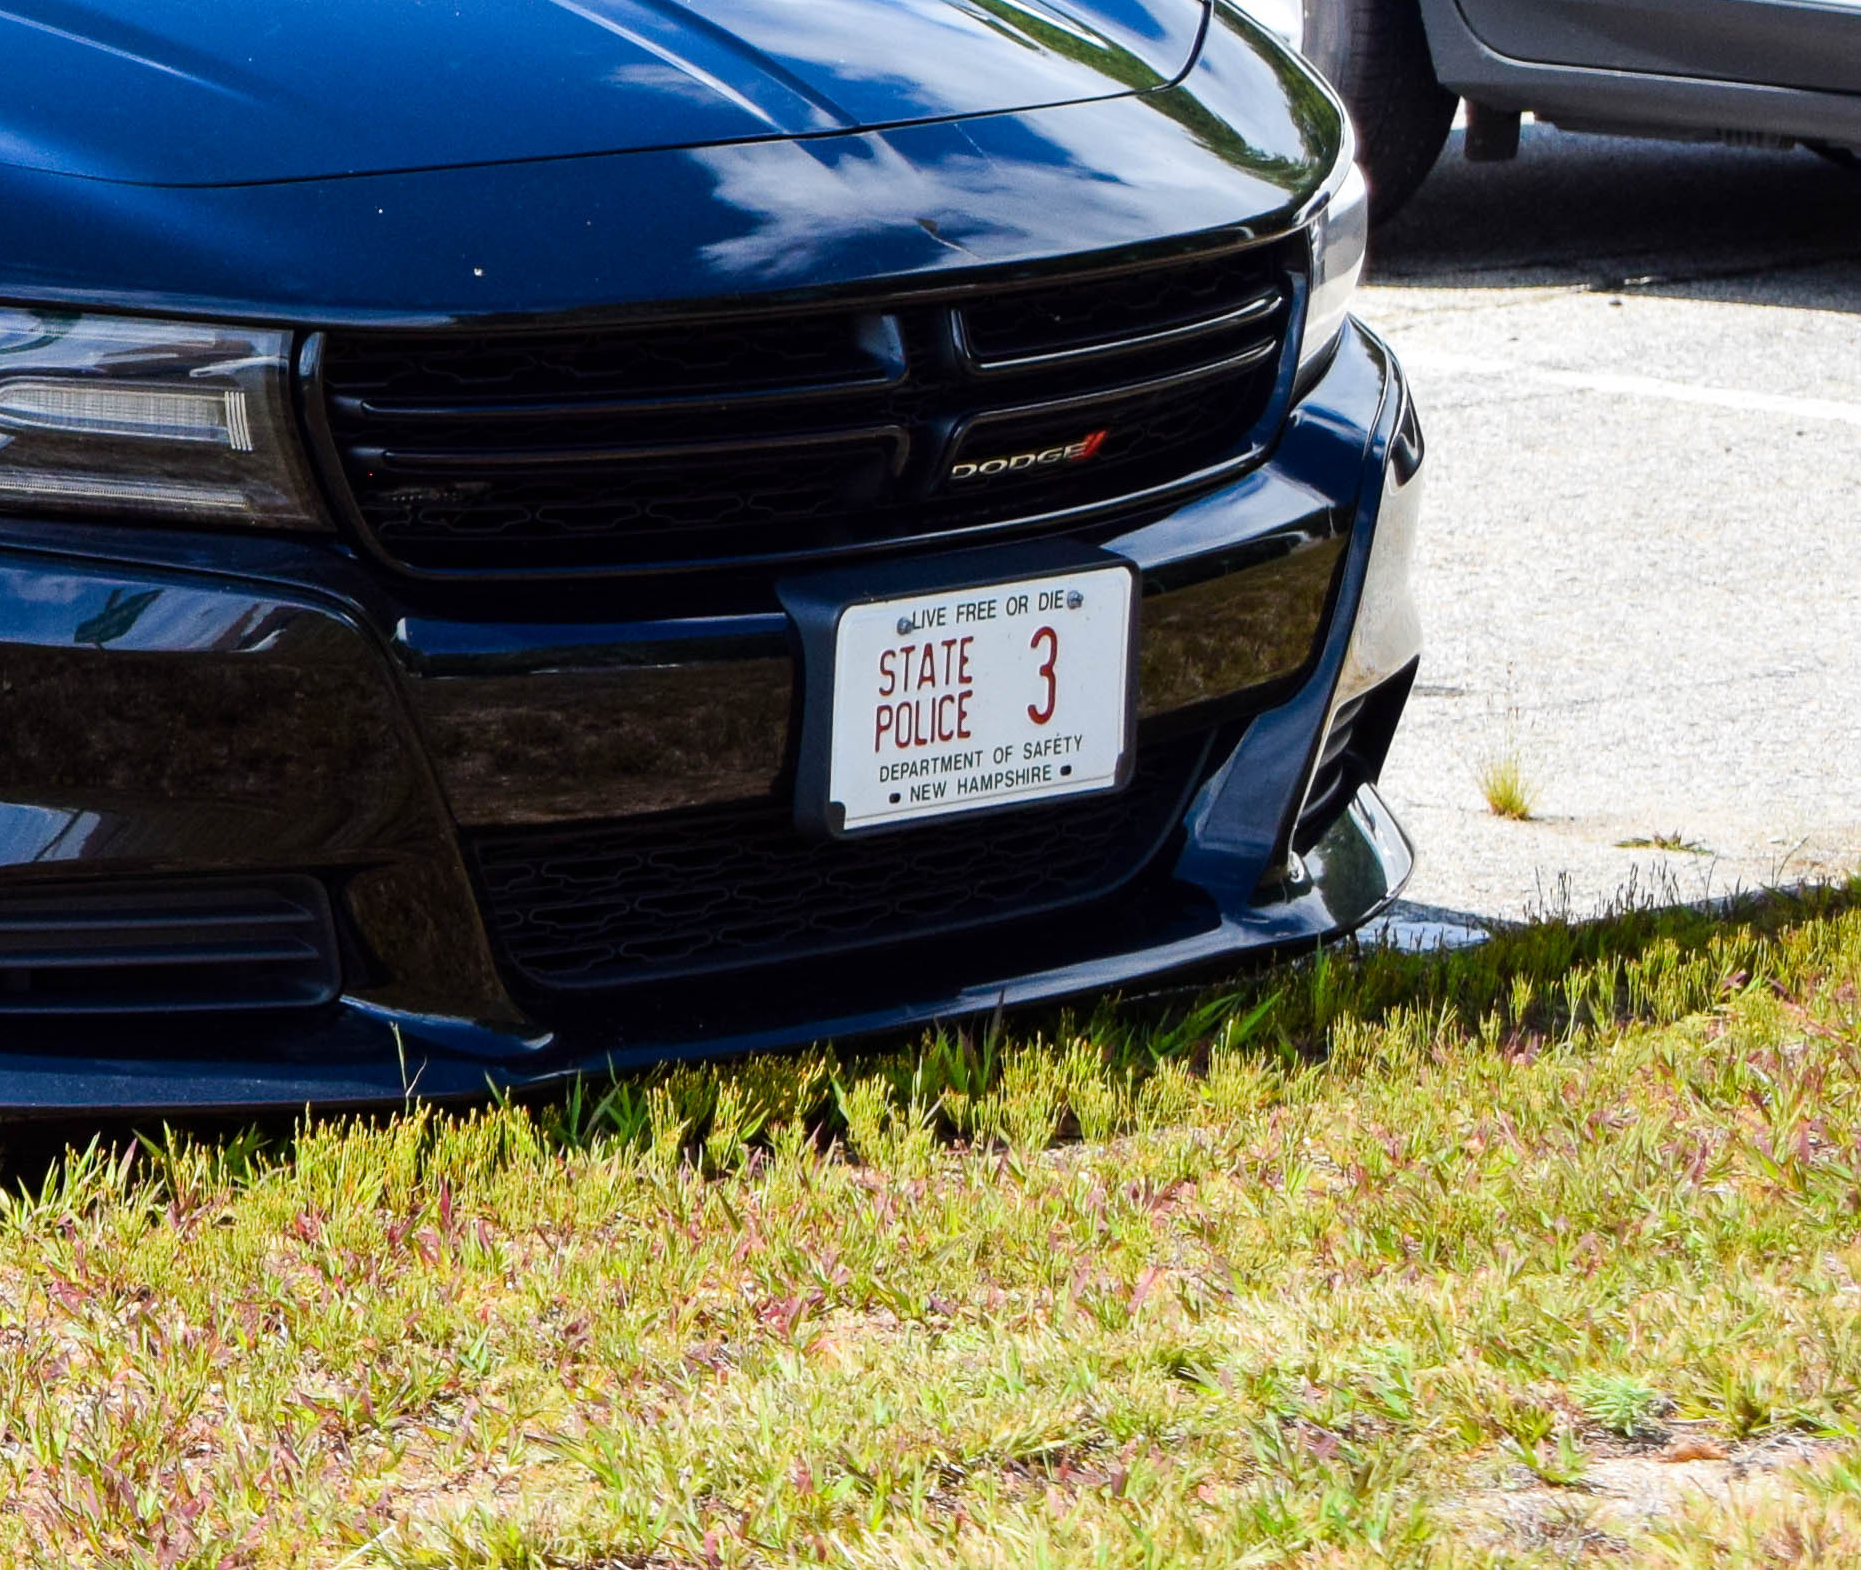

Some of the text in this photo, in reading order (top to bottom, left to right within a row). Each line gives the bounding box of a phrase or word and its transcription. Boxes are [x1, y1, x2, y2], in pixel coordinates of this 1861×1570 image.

[951, 440, 1088, 479] DODGE
[912, 589, 1065, 630] LIVE FREE OR DIE
[878, 626, 1059, 725] STATE 3
[874, 689, 974, 753] POLICE
[879, 734, 1083, 783] DEPARTMENT OF SAFETY
[909, 764, 1052, 802] NEW HAMPSHIRE
